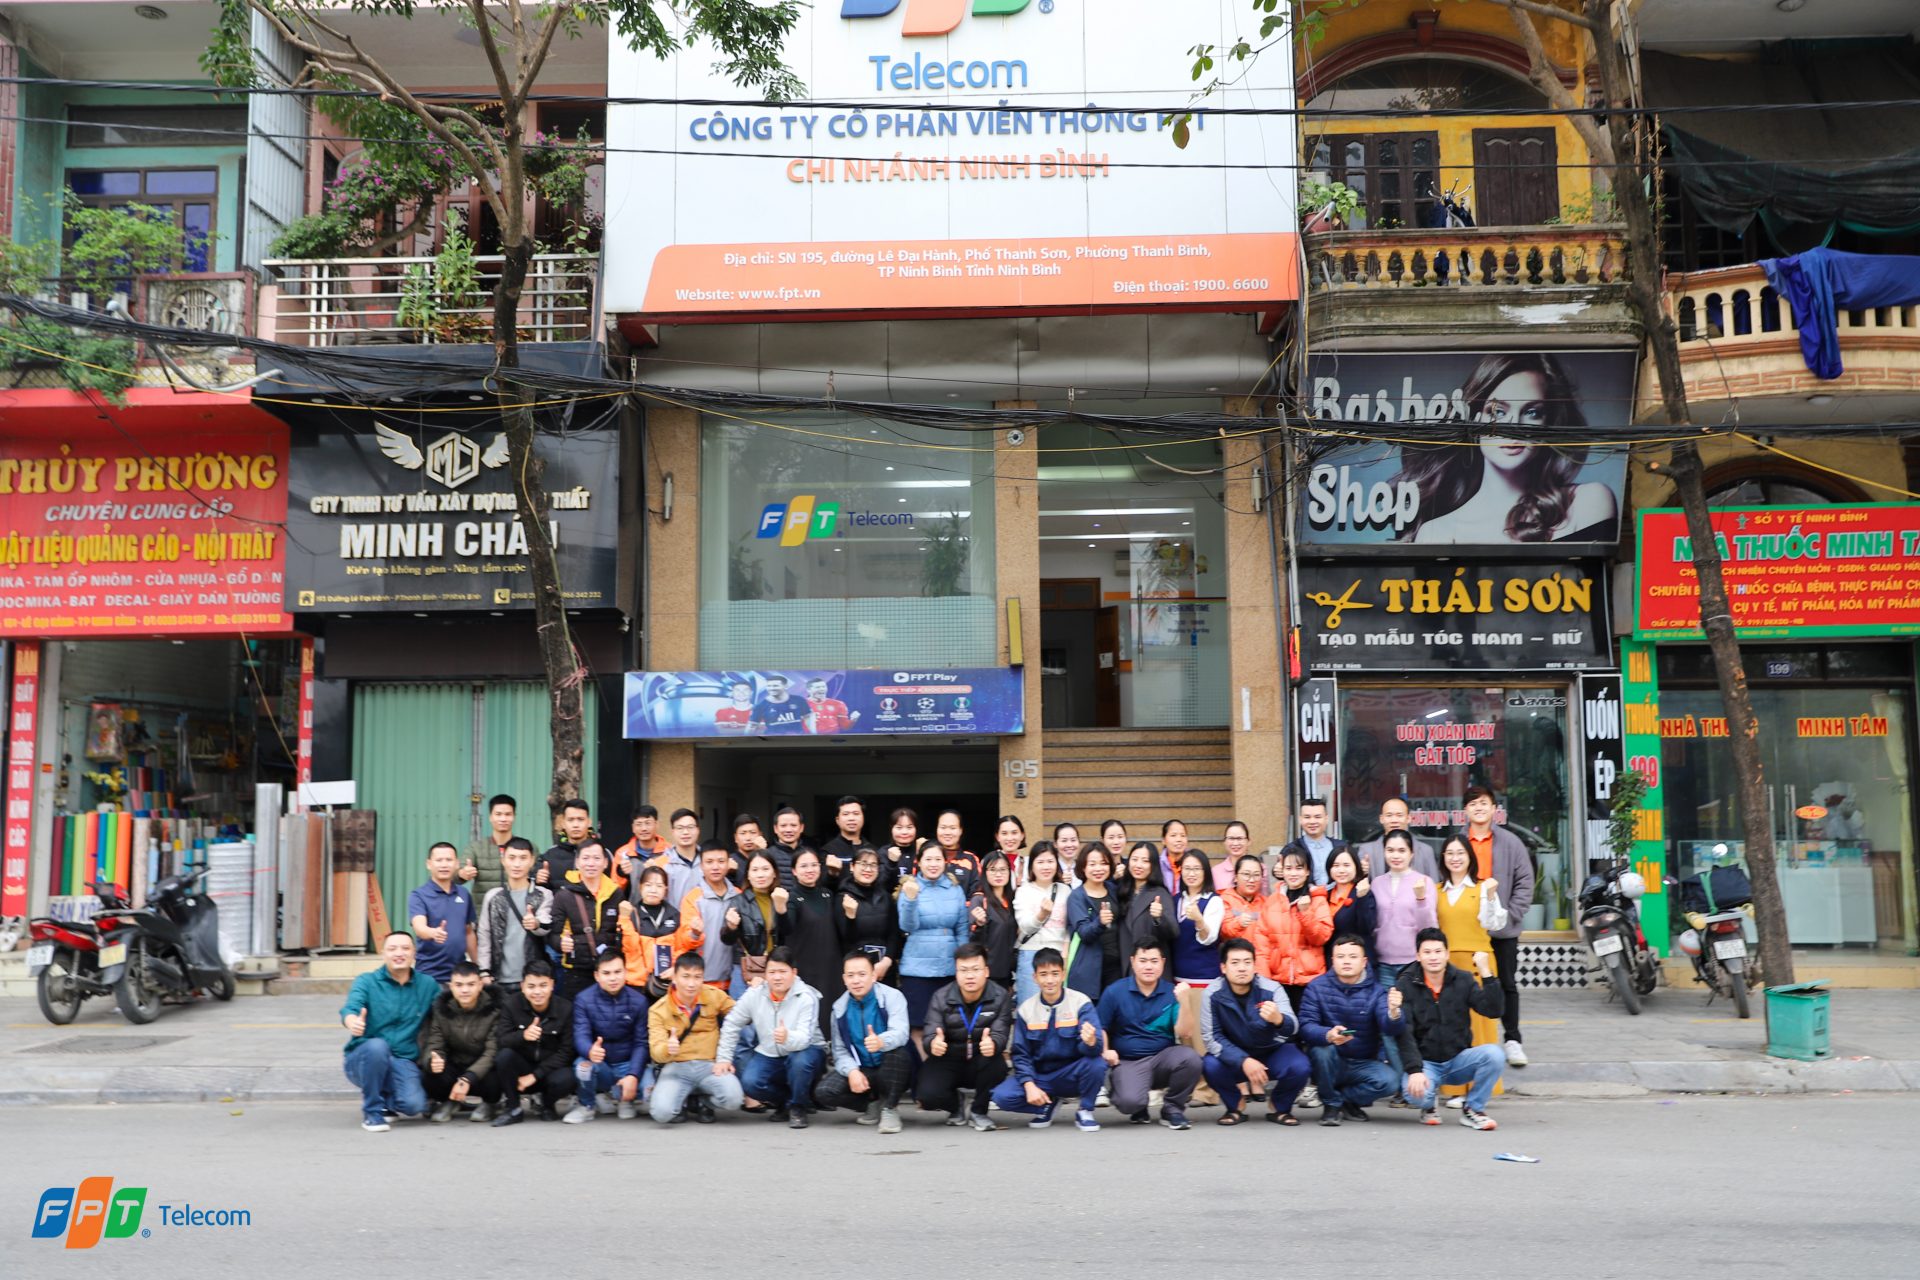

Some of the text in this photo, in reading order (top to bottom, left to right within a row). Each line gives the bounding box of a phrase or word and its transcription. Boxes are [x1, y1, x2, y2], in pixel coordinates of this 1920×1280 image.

[869, 52, 1027, 90] Telecom
[690, 111, 772, 140] CÔNG
[780, 115, 818, 139] TY
[877, 103, 957, 137] PHẦN
[966, 99, 1032, 135] VIỄN
[1039, 103, 1147, 133] THÔNG
[1157, 107, 1208, 132] FT
[787, 148, 1109, 183] CHI NHÁNH NINH BÌNH
[724, 243, 1211, 265] Địa chỉ: SN 195, đường Lê Đại Hành, Phố Thanh Sơn, Phường Thanh Bình,
[878, 263, 1061, 278] TP Ninh Bình Tỉnh Ninh Bình
[675, 286, 821, 301] Website: www.fpt.vn
[1113, 280, 1145, 295] Điện
[1149, 279, 1190, 294] thoại:
[1233, 279, 1268, 291] 6600
[1313, 377, 1470, 425] Barber
[0, 444, 278, 494] THỦY PHƯƠNG
[310, 496, 340, 514] CTY
[382, 494, 404, 513] TƯ
[406, 489, 437, 512] VẤN
[439, 491, 470, 511] XÂY
[473, 492, 517, 514] DỰNG
[552, 486, 591, 509] THẤT
[1308, 464, 1421, 531] Shop
[46, 500, 128, 521] CHUYÊN
[129, 503, 187, 520] CUNG
[848, 510, 913, 526] Telecom
[1754, 510, 1868, 524] SỞ Y TẾ NINH BÌNH
[33, 530, 74, 569] LIỆU
[76, 523, 139, 566] QUẢNG
[142, 527, 180, 562] CÁO
[193, 528, 228, 566] NỘI
[341, 523, 443, 558] MINH
[1673, 525, 1894, 562] NÀ THUỐC MINH
[0, 575, 25, 588] IKA
[1380, 567, 1593, 613] THÁI SƠN
[1732, 579, 1769, 595] THUỐC
[1773, 580, 1804, 594] CHỮA
[1839, 581, 1868, 593] THỰC
[1733, 602, 1749, 614] CỤ
[1752, 602, 1759, 612] Y
[1839, 596, 1863, 610] HÓA
[1317, 628, 1583, 648] TẠO MẪU TÓC NAM NỮ
[911, 673, 957, 682] FPT Play
[1769, 664, 1790, 675] 199
[1301, 688, 1331, 743] CẮT
[1585, 687, 1619, 740] UỐN
[1625, 692, 1660, 735] THUỐC
[1661, 713, 1888, 738] NHÀ MINH TÂM
[1397, 720, 1425, 741] UỐN
[1466, 719, 1496, 740] MÁY
[1415, 741, 1476, 766] CẮT TÓC
[1003, 760, 1039, 778] 195
[1594, 751, 1615, 799] ÉP
